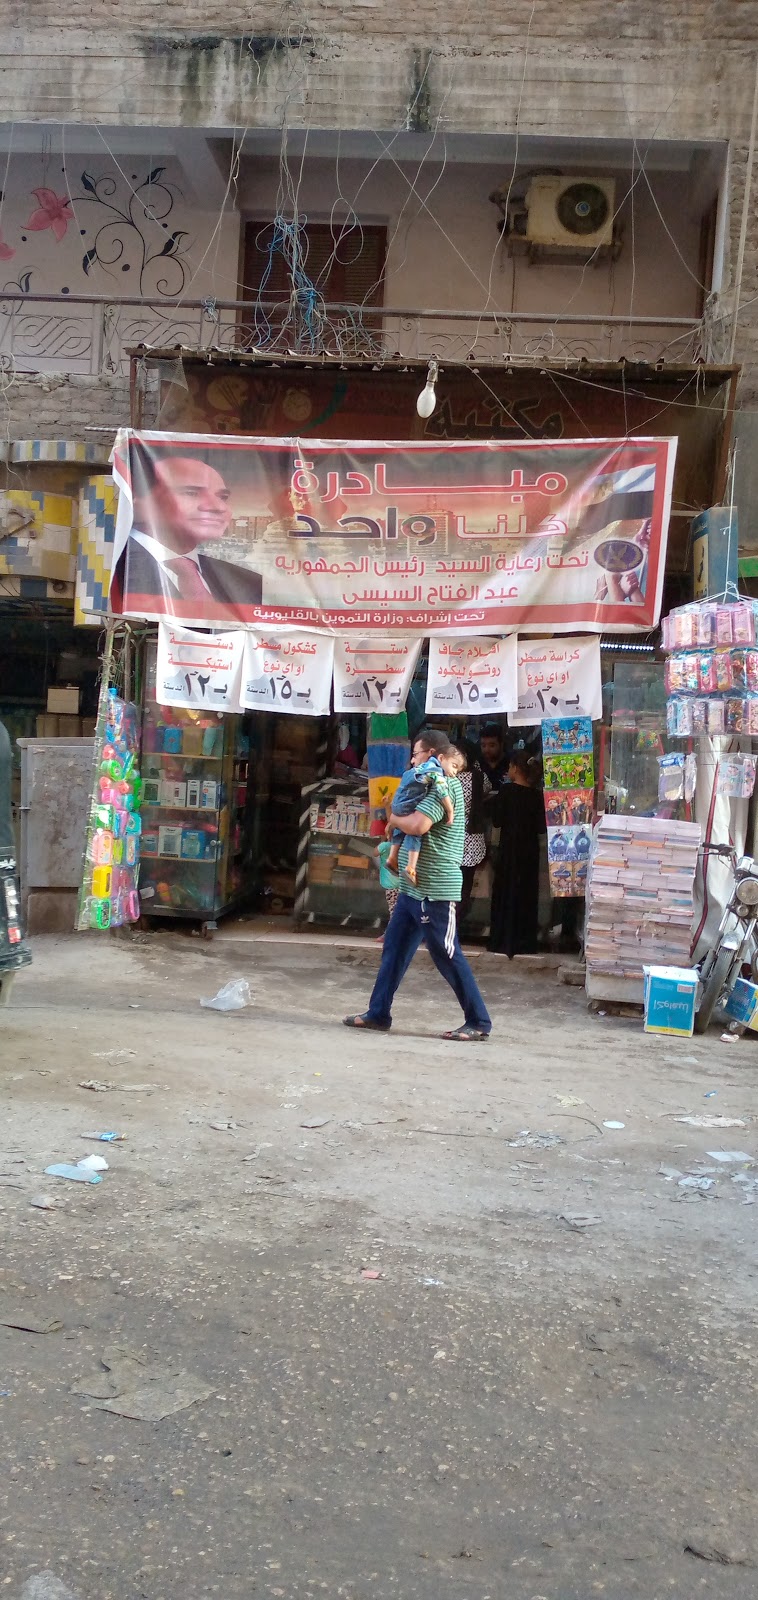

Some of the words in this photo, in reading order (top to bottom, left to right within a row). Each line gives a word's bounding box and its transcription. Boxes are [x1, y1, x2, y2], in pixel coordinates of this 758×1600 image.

[290, 459, 568, 502] مبادرة
[287, 506, 438, 546] واحد
[456, 512, 568, 539] كلنا
[373, 555, 425, 578] رئيس
[436, 555, 490, 578] السيد
[495, 553, 541, 576] رعاية
[546, 551, 589, 569] تحت
[427, 583, 480, 606] الفتاح
[484, 585, 519, 604] عبد
[253, 607, 319, 623] بالقليوبية
[322, 612, 370, 624] التموين
[373, 612, 404, 625] وزارة
[406, 611, 451, 625] إشراف:
[454, 611, 485, 622] تحت
[169, 632, 234, 651] دستة
[253, 638, 282, 651] مسطر
[283, 641, 317, 656] كشكول
[344, 642, 408, 655] دستة
[438, 643, 464, 659] جاف
[549, 648, 580, 663] كراسة
[168, 652, 233, 672] استيكة
[263, 660, 280, 673] نوع
[518, 652, 547, 666] مسطر
[345, 663, 406, 676] مسطرة
[437, 664, 466, 679] ليكود
[163, 681, 184, 692] الدستة
[527, 672, 544, 687] نوع
[246, 684, 268, 694] الدستة
[342, 690, 364, 699] الدستة
[433, 691, 456, 700] الدستة
